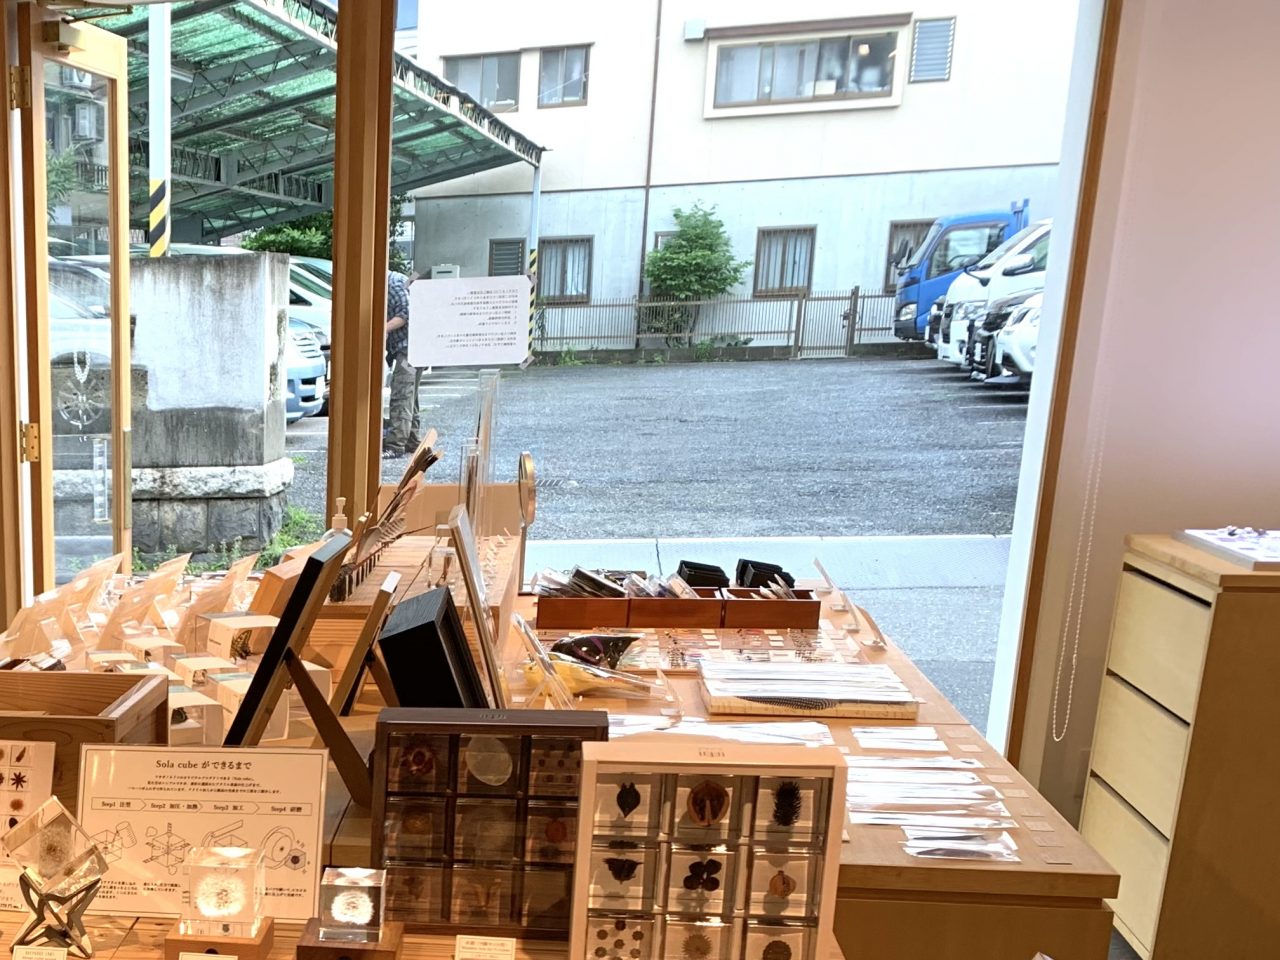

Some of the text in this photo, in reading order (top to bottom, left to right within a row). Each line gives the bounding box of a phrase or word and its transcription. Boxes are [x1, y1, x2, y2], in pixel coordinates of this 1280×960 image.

[156, 759, 252, 770] Sola cube ができるまで
[101, 801, 117, 809] Step1
[213, 804, 229, 812] Step3
[271, 806, 286, 814] Step4
